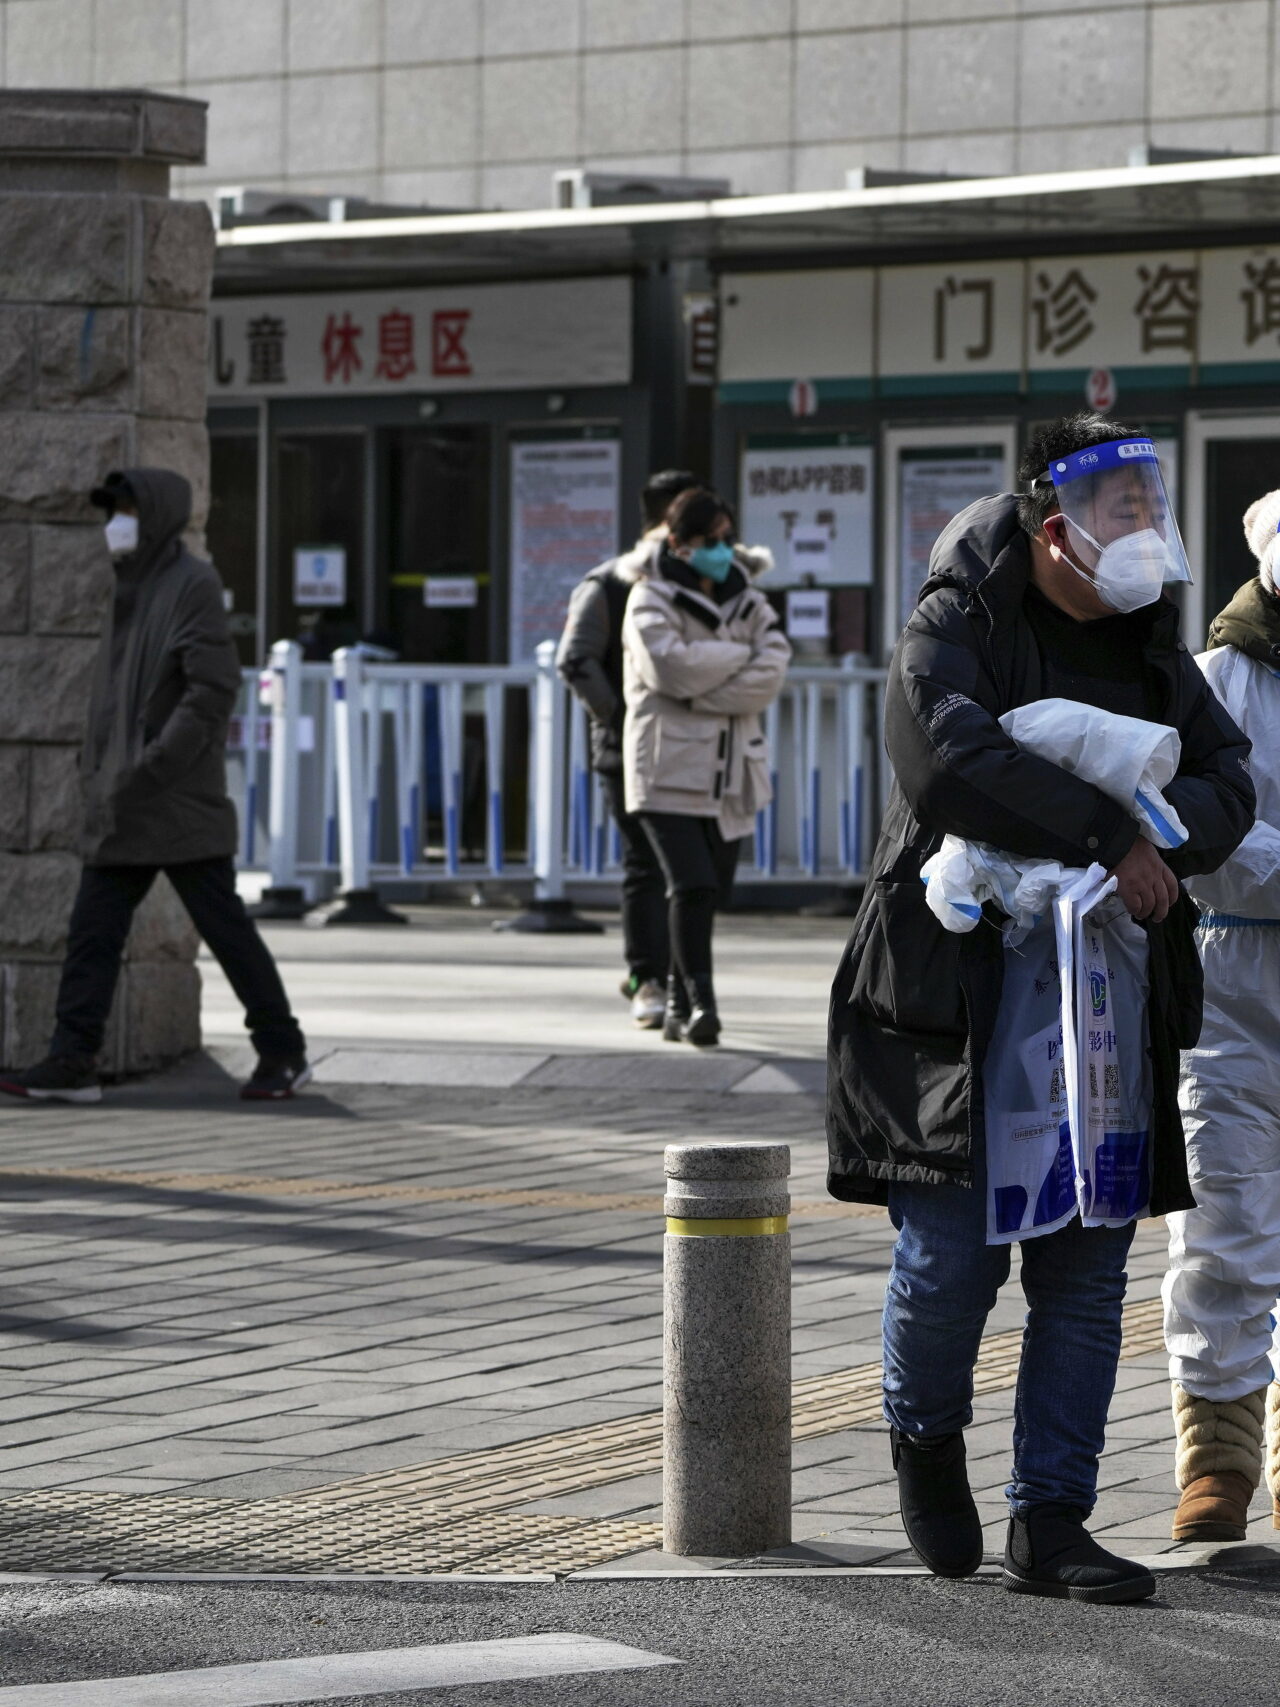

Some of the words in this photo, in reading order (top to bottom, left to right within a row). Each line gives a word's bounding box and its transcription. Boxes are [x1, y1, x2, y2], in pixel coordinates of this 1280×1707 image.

[320, 307, 473, 384] 休息区
[1092, 370, 1110, 408] 2
